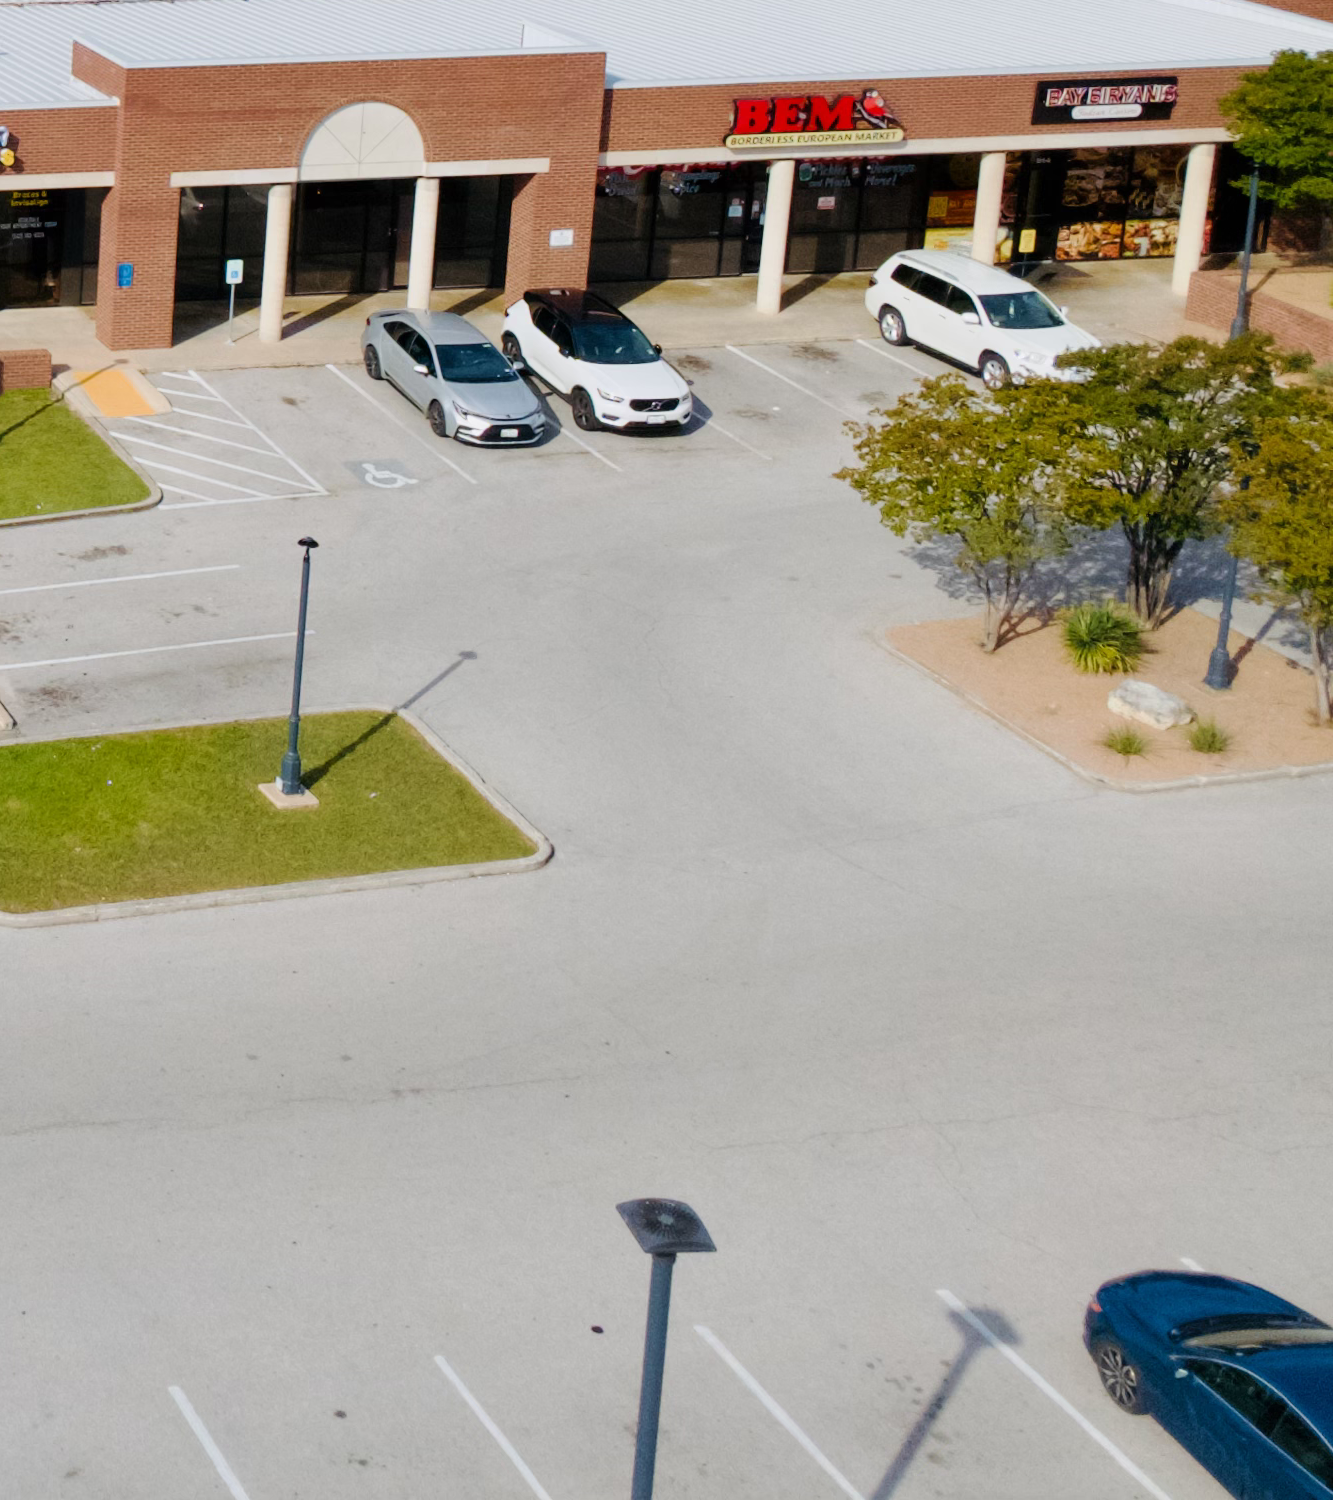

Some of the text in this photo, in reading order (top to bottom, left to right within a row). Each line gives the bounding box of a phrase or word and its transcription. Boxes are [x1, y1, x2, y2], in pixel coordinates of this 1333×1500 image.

[734, 96, 856, 135] BEM
[730, 131, 898, 146] BORDERLESS EUROPEAN MARKET
